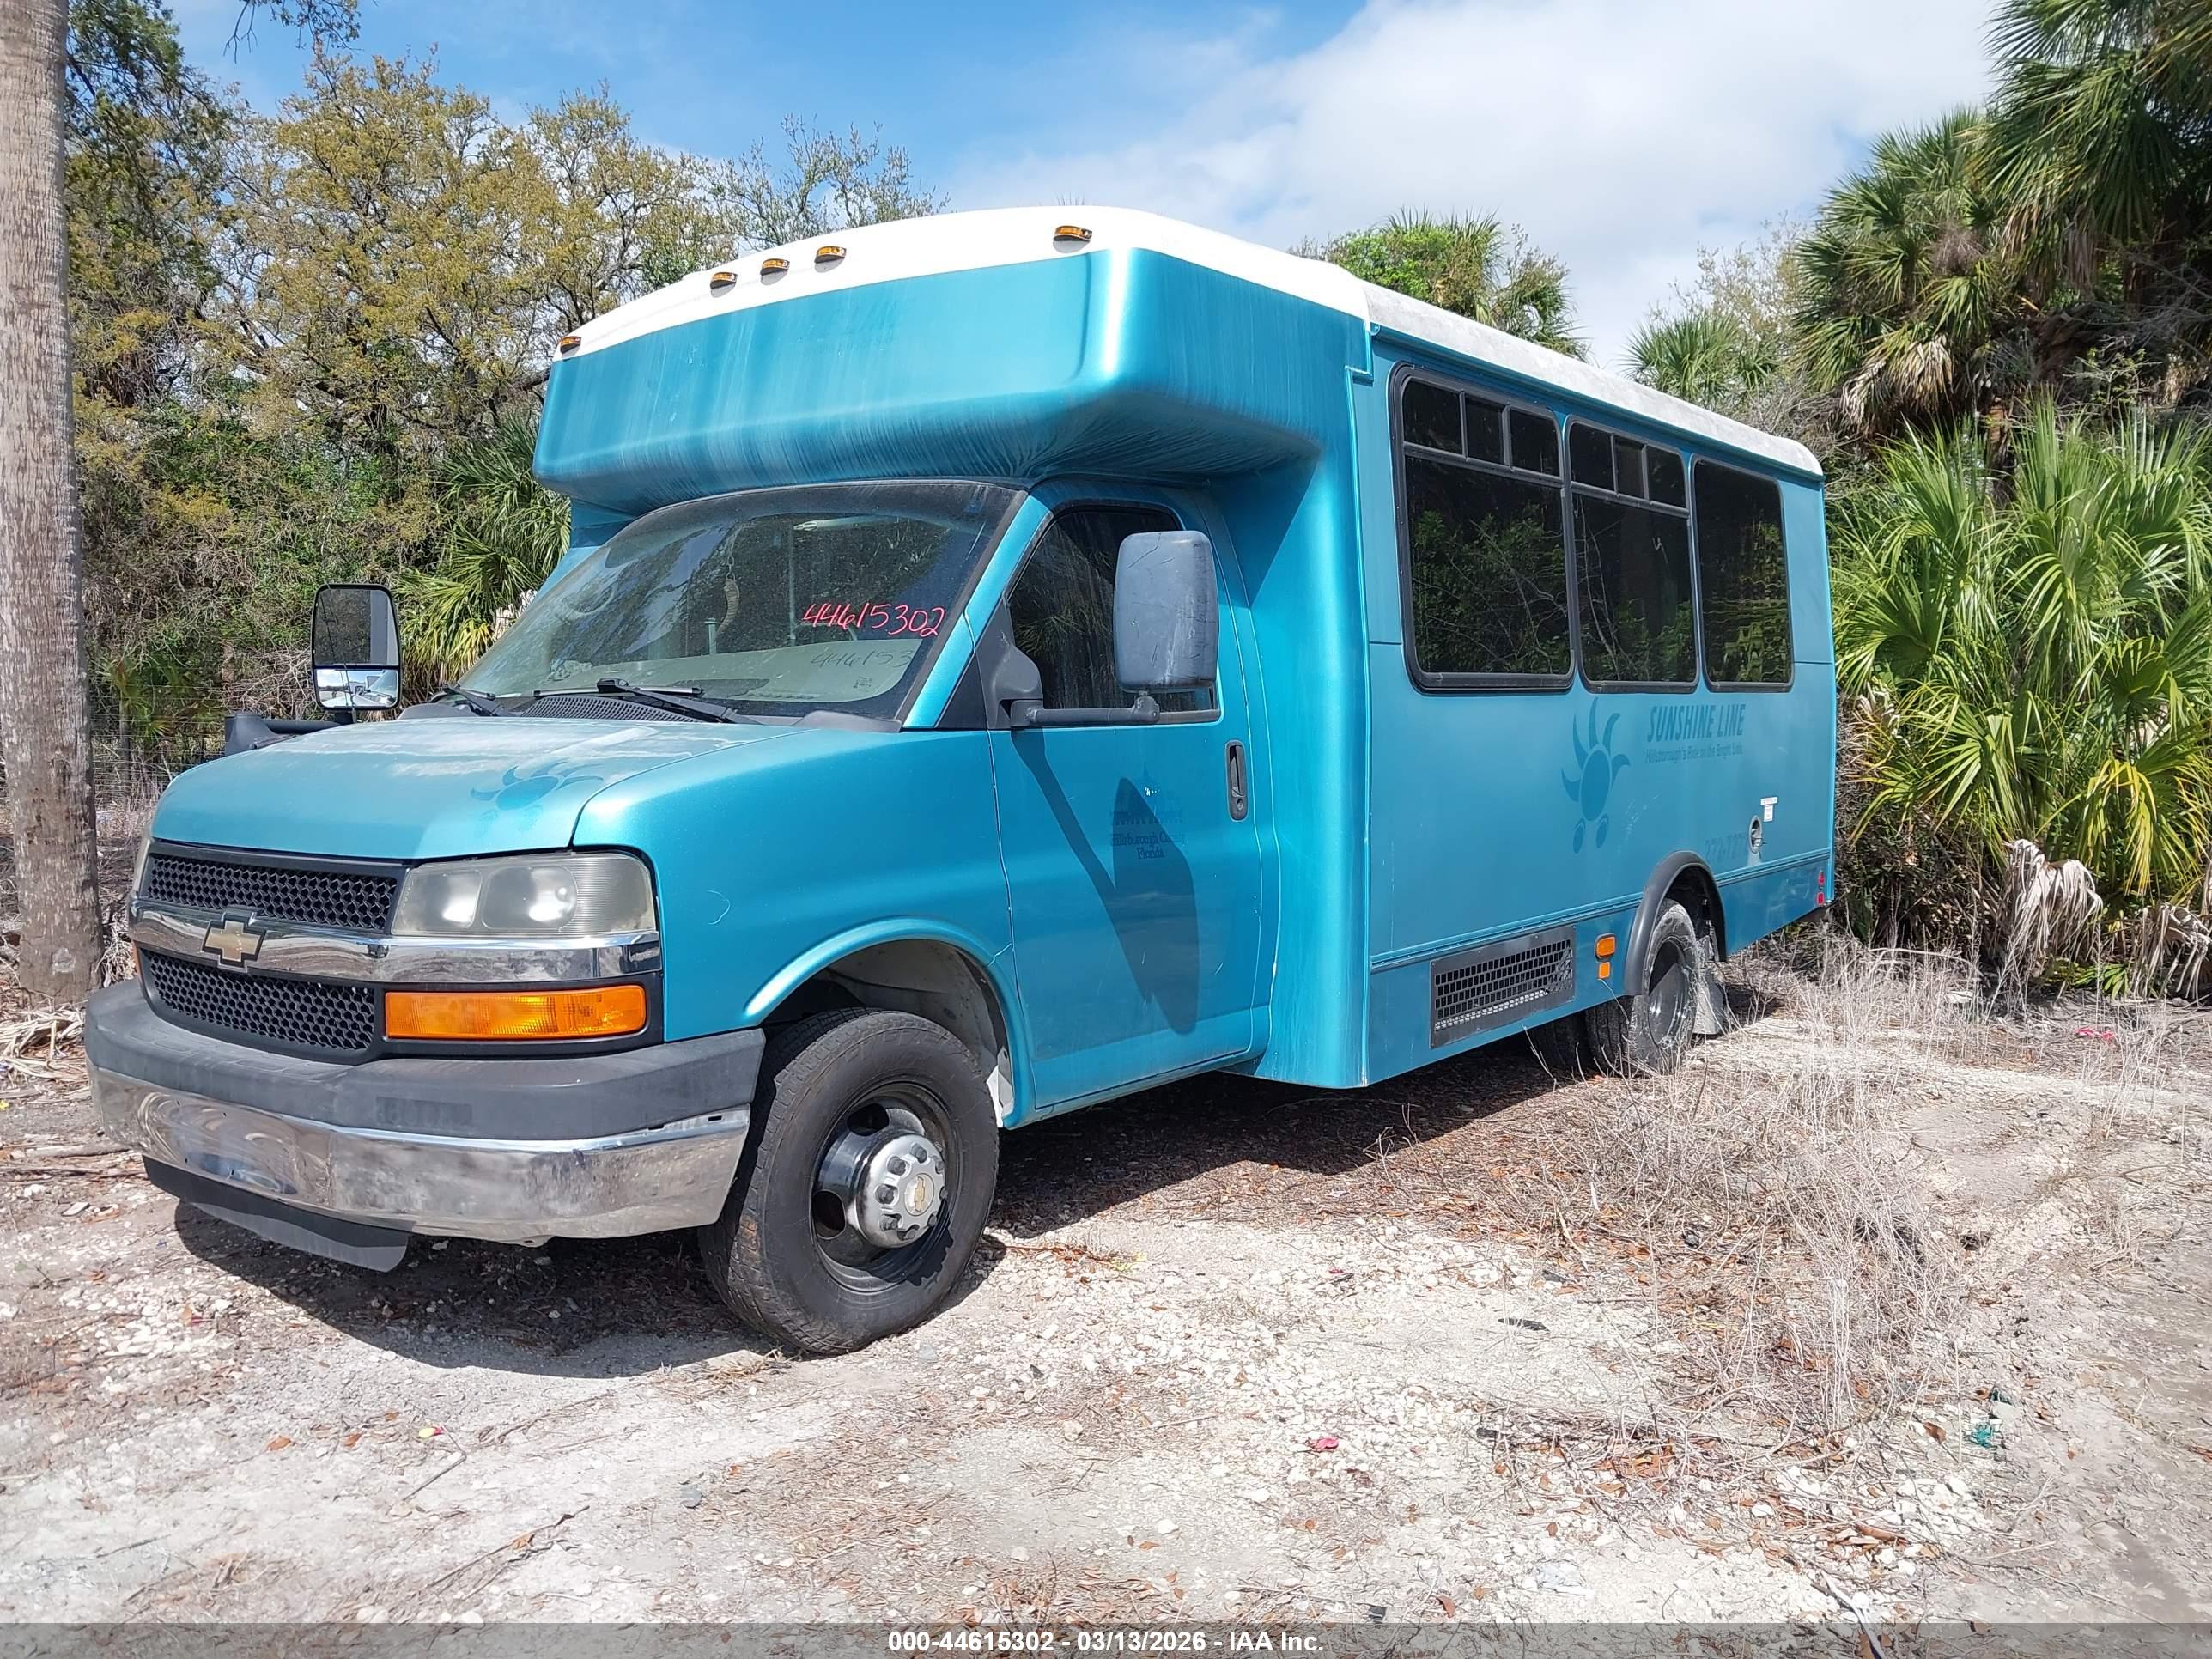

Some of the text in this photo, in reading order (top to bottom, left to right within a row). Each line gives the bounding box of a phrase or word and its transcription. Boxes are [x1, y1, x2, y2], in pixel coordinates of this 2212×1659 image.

[802, 602, 946, 637] 44615302
[1647, 703, 1746, 743] SUNSHINE LINE
